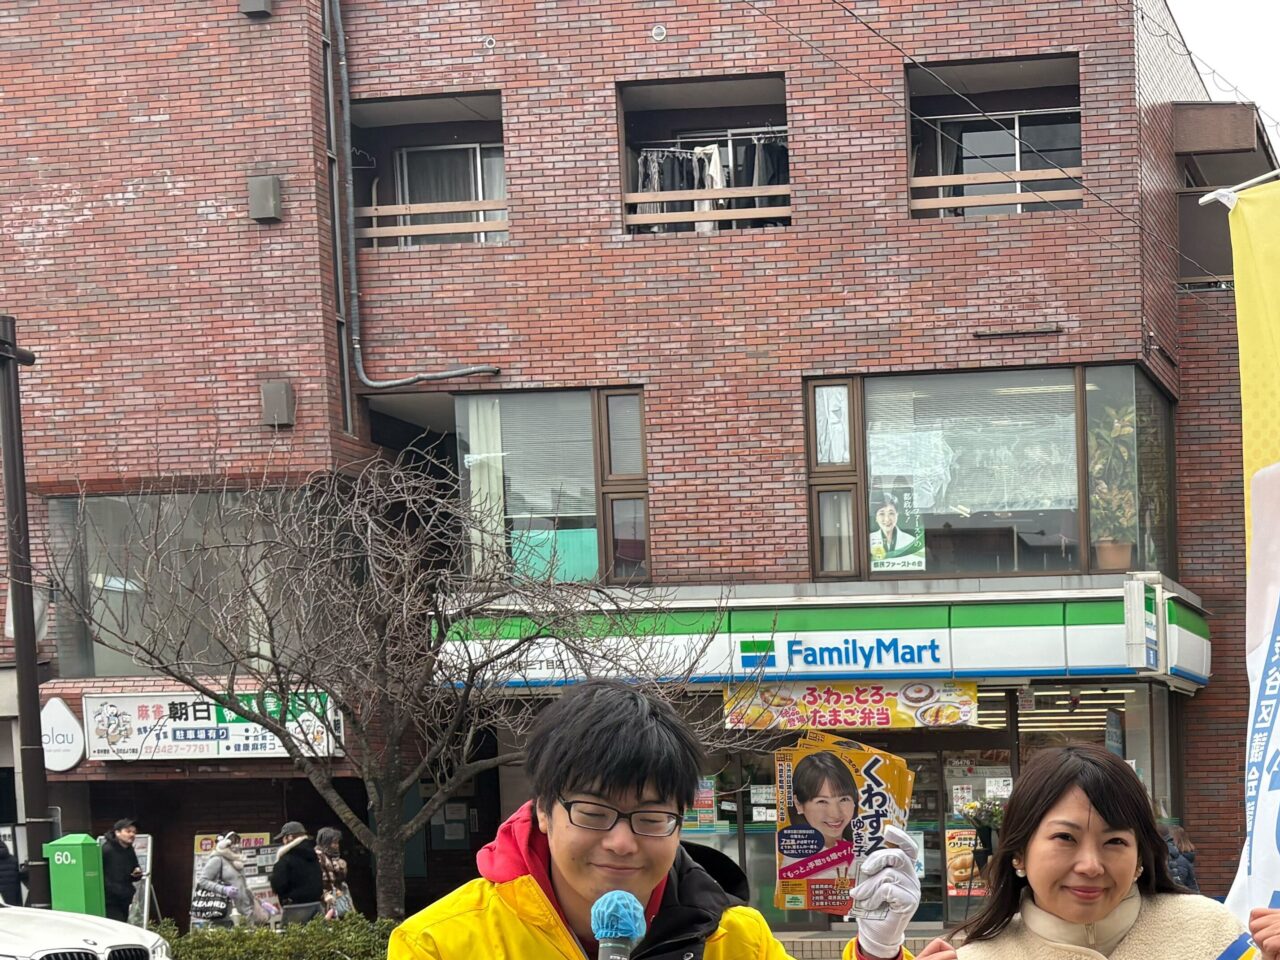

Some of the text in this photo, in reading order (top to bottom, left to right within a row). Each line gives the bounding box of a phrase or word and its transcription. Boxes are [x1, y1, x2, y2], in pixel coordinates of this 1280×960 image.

[787, 638, 941, 668] FamilyMart
[168, 701, 211, 721] 朝日
[809, 707, 890, 727] たまご弁当
[852, 818, 865, 857] ゆき子
